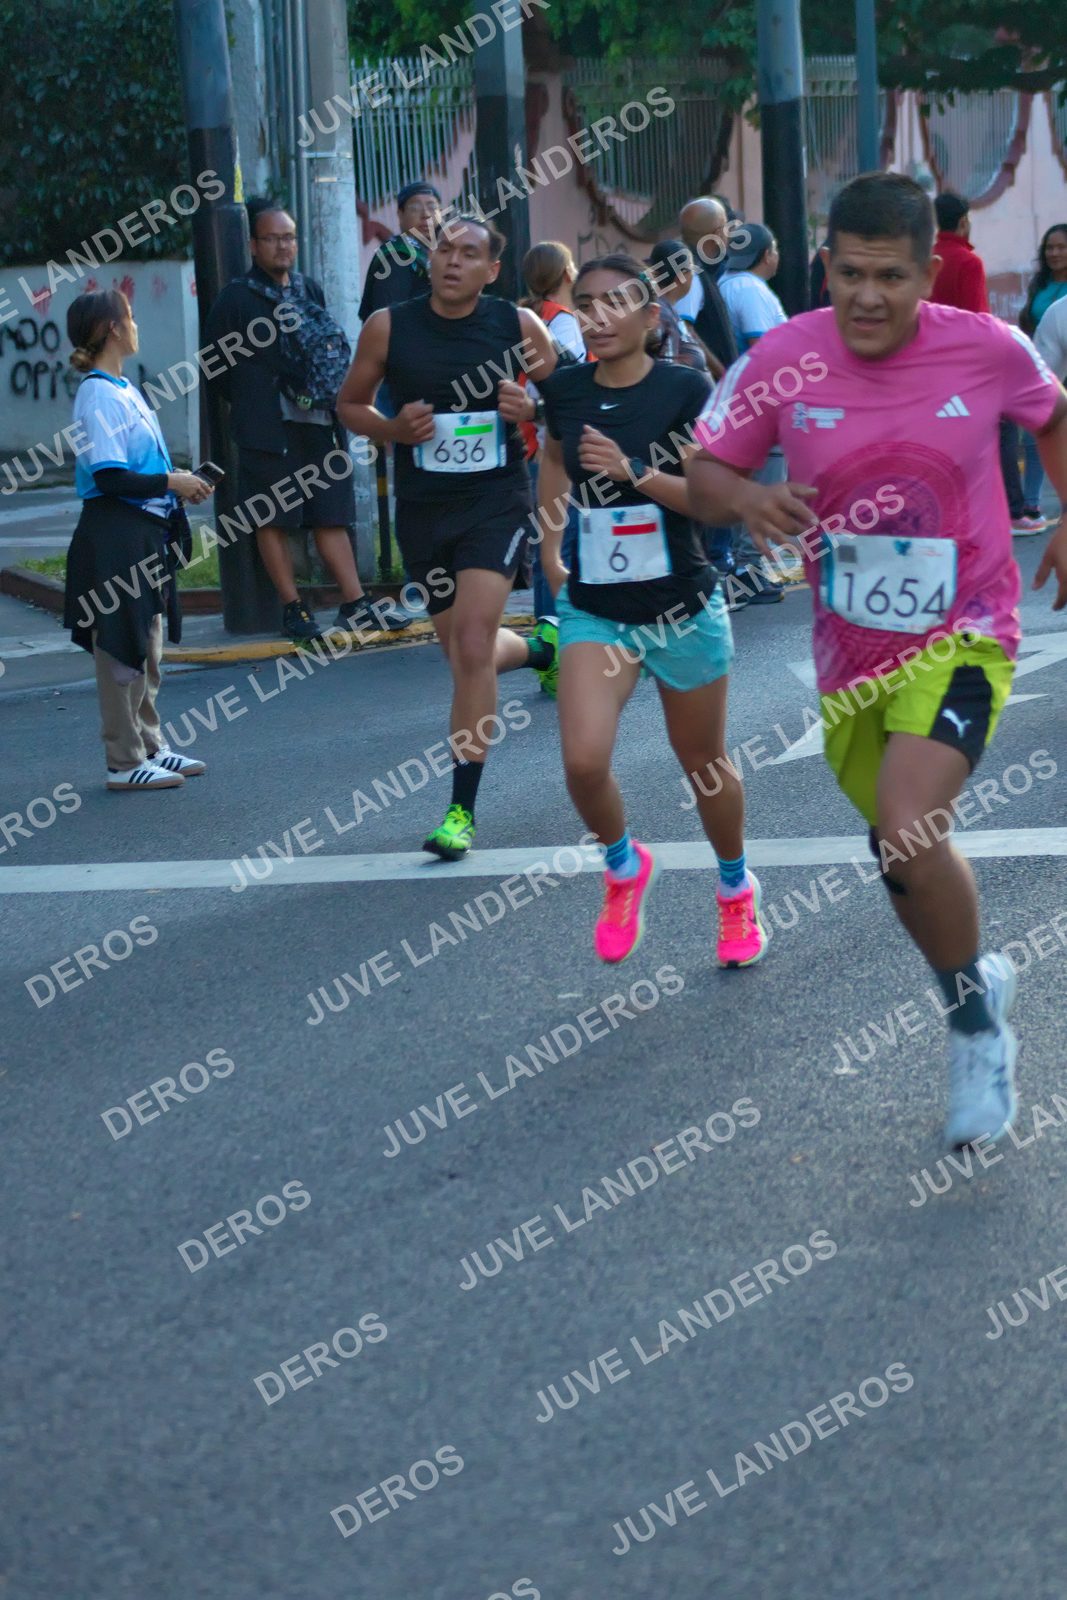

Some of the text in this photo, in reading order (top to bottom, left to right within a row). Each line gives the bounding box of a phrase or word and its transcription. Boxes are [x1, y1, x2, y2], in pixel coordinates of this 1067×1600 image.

[434, 438, 486, 464] 636
[609, 541, 629, 573] 6
[843, 572, 947, 619] 1654
